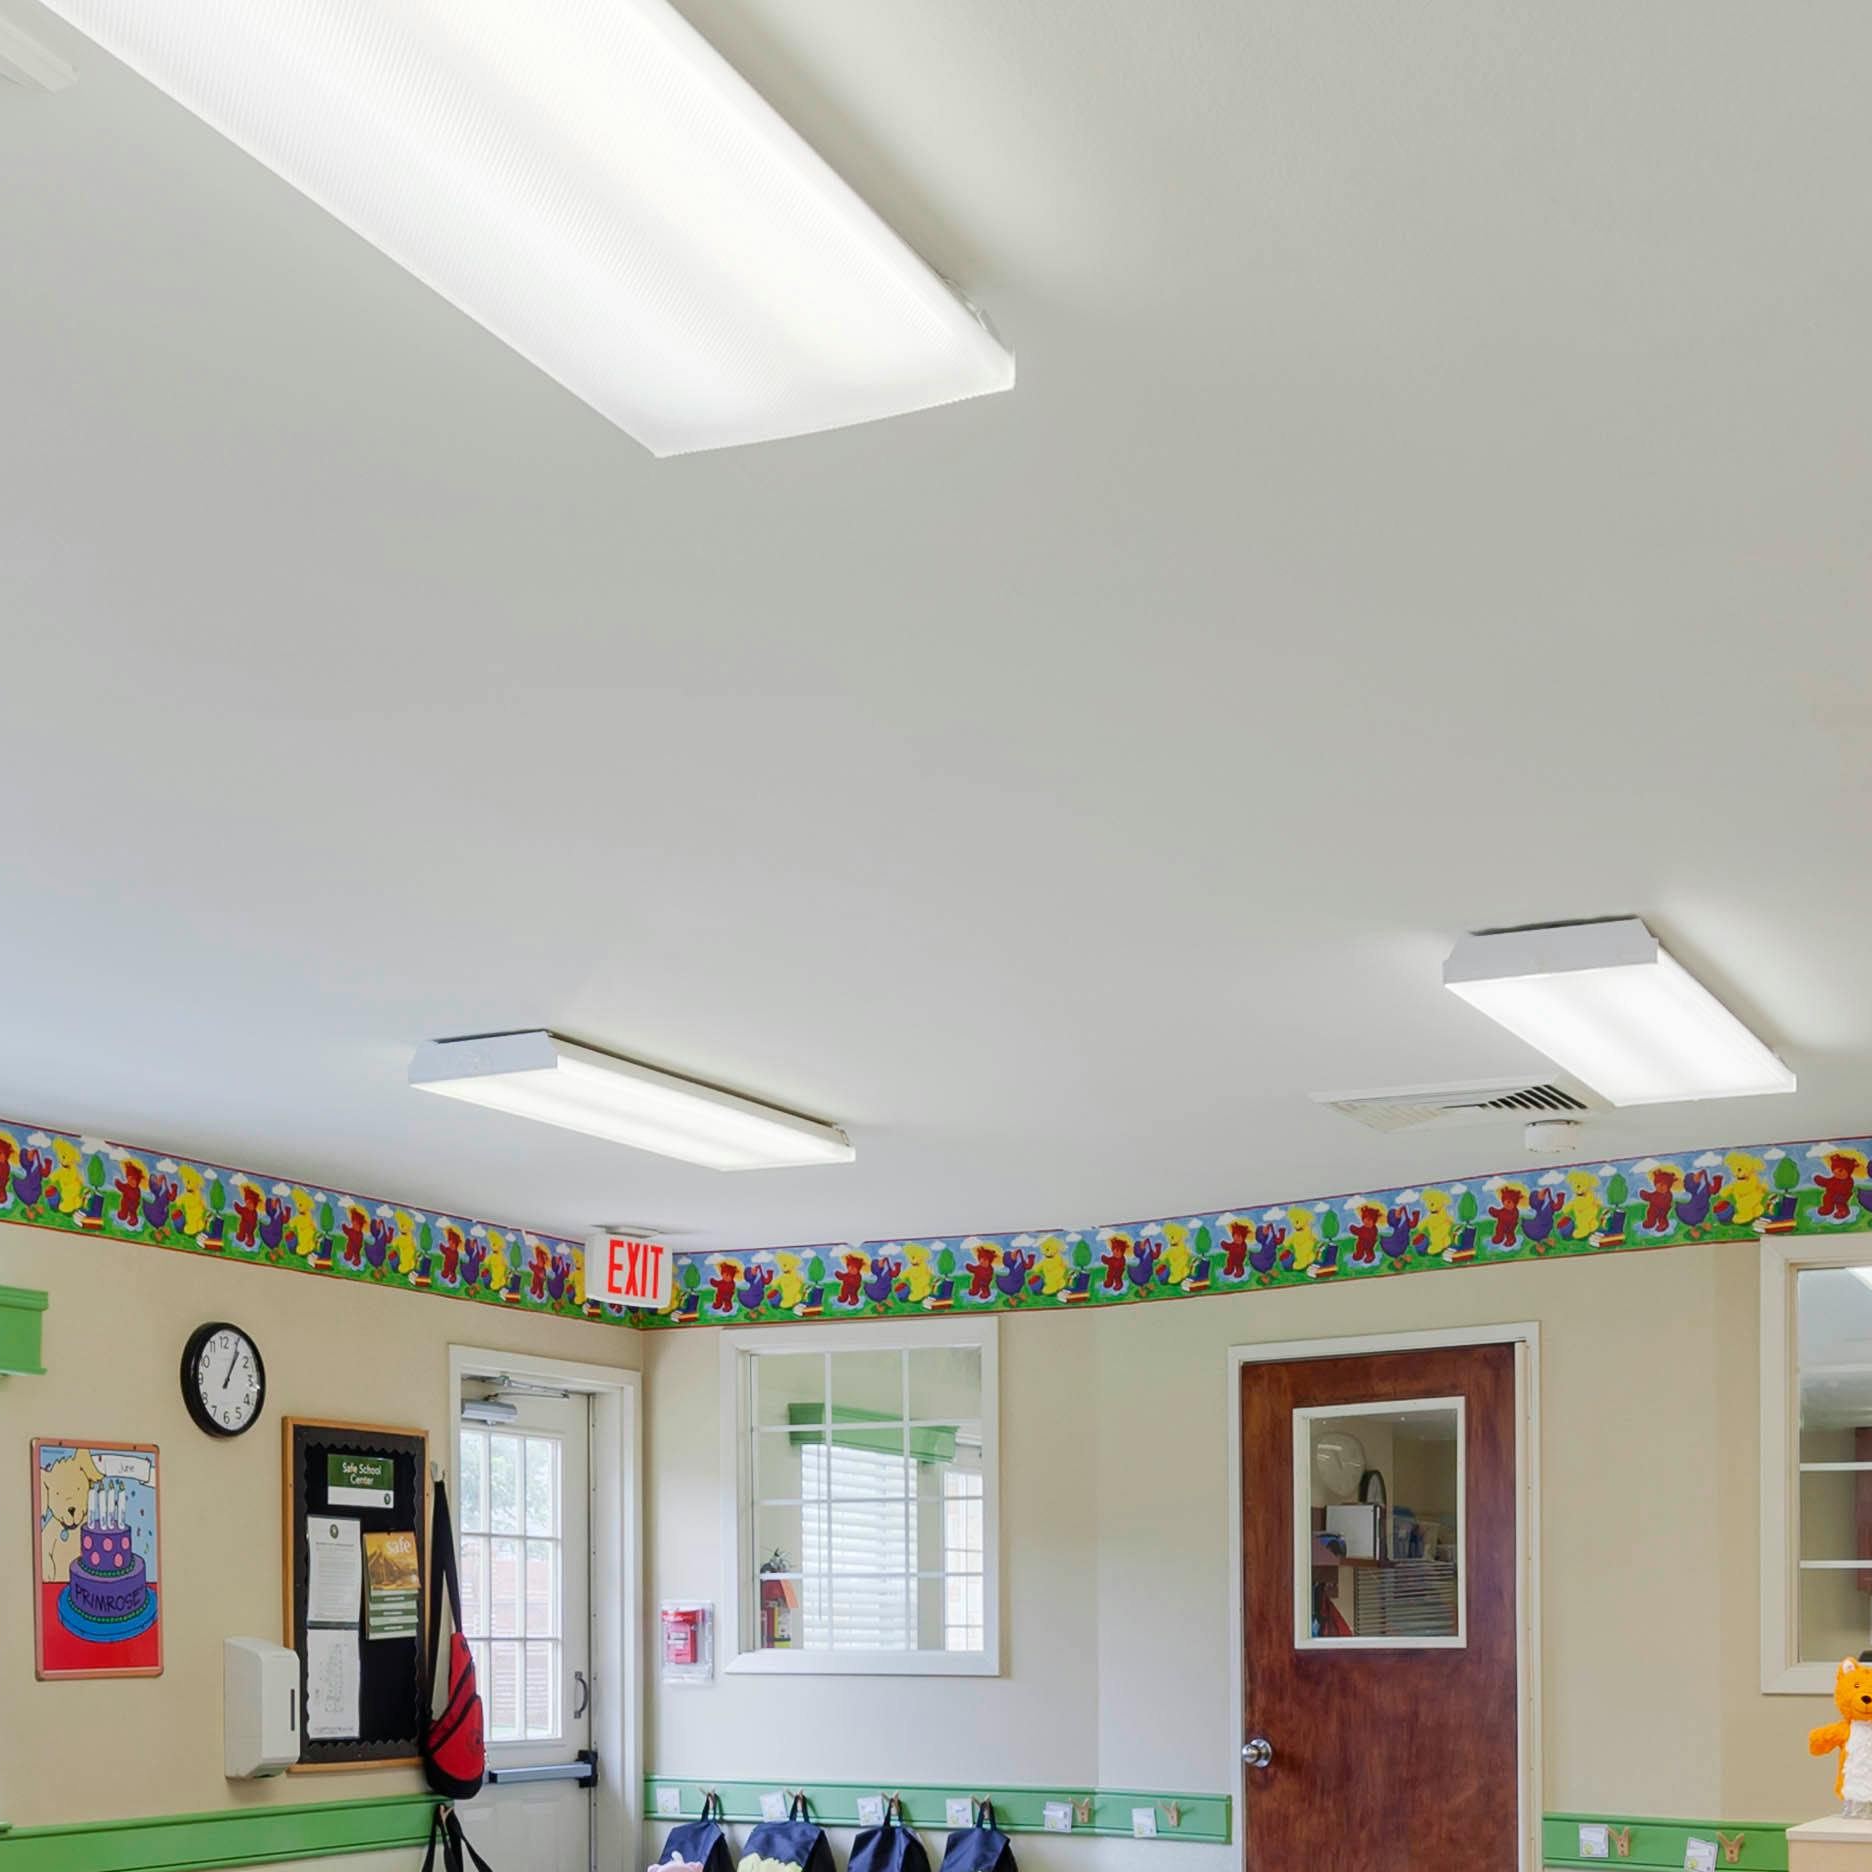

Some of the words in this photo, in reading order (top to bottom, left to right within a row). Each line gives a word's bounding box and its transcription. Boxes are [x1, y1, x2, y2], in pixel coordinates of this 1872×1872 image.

[607, 1238, 664, 1300] EXIT
[209, 1340, 216, 1353] 11
[219, 1335, 230, 1350] 12
[242, 1355, 249, 1369] 2
[243, 1392, 251, 1406] 4
[210, 1404, 218, 1418] 7
[223, 1410, 231, 1425] 6
[234, 1405, 242, 1420] 5
[341, 1461, 358, 1475] Safe
[358, 1463, 382, 1476] School
[349, 1473, 374, 1487] Center
[384, 1535, 413, 1555] safe
[74, 1582, 143, 1613] PRIMROSE
